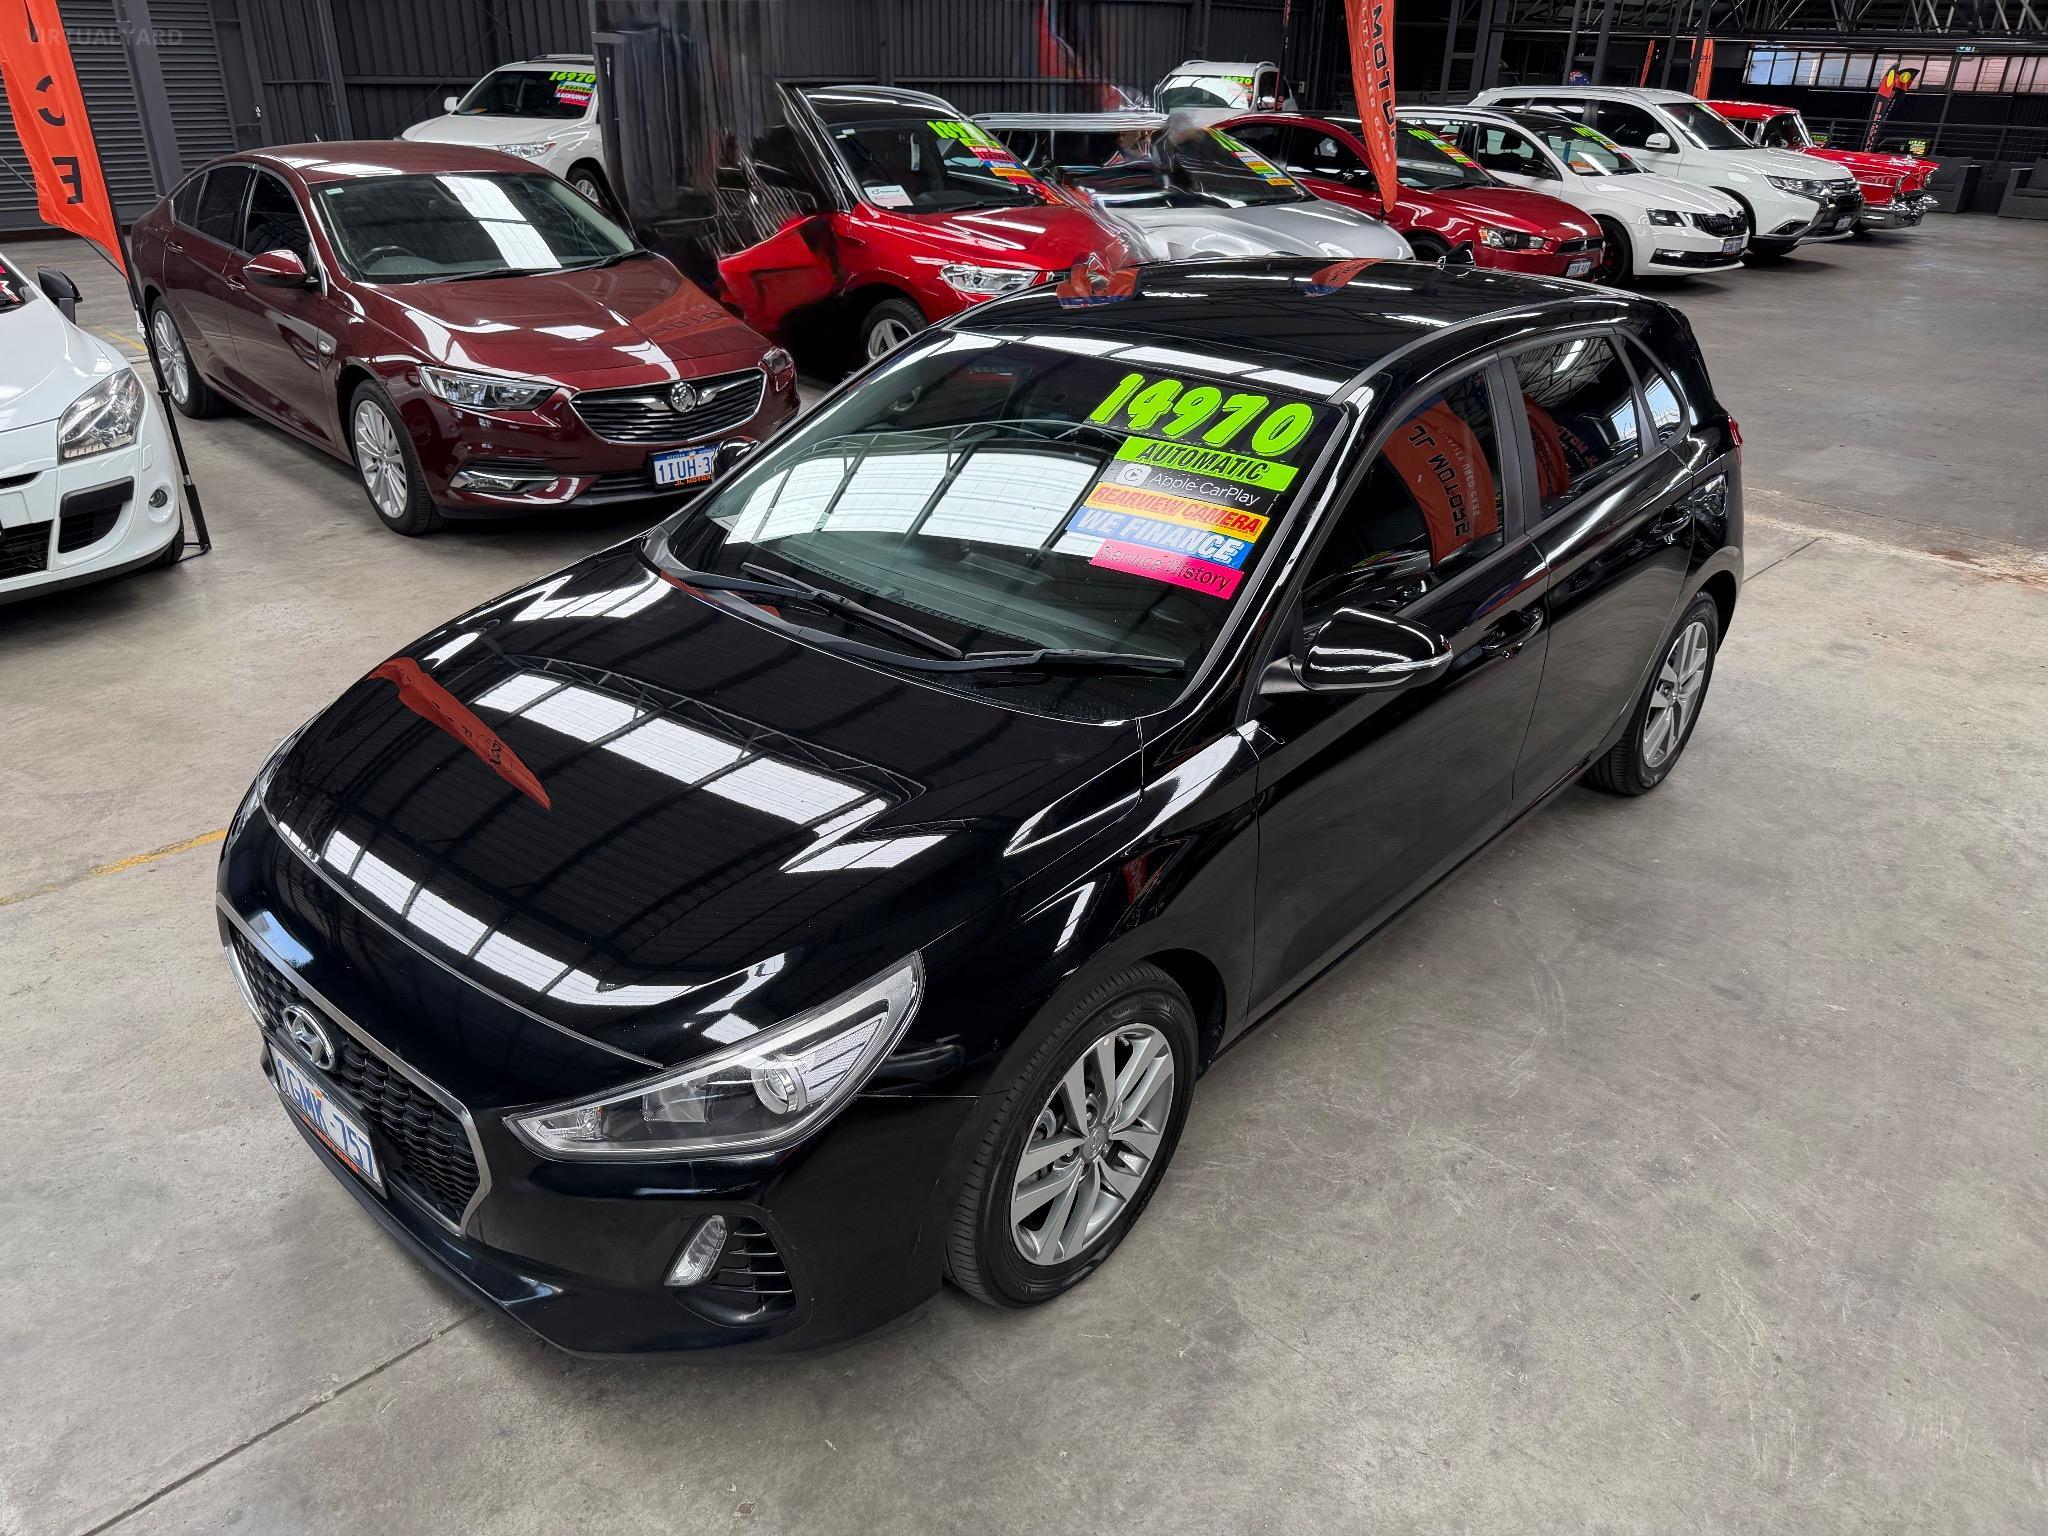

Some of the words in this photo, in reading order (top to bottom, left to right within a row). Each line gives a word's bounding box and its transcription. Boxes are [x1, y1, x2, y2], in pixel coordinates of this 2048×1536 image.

[549, 71, 597, 83] 16970
[555, 93, 589, 101] LUXURY
[1089, 373, 1313, 456] 14970
[1136, 442, 1270, 483] AUTOMATIC
[1149, 471, 1197, 493] Apple
[1199, 480, 1260, 506] CarPlay
[1093, 487, 1183, 515] REARVIEW
[1180, 504, 1261, 535] CAMERA
[1078, 509, 1122, 534] WE
[1120, 517, 1244, 564] FINANCE
[1099, 543, 1164, 575] Service
[1164, 555, 1232, 592] History
